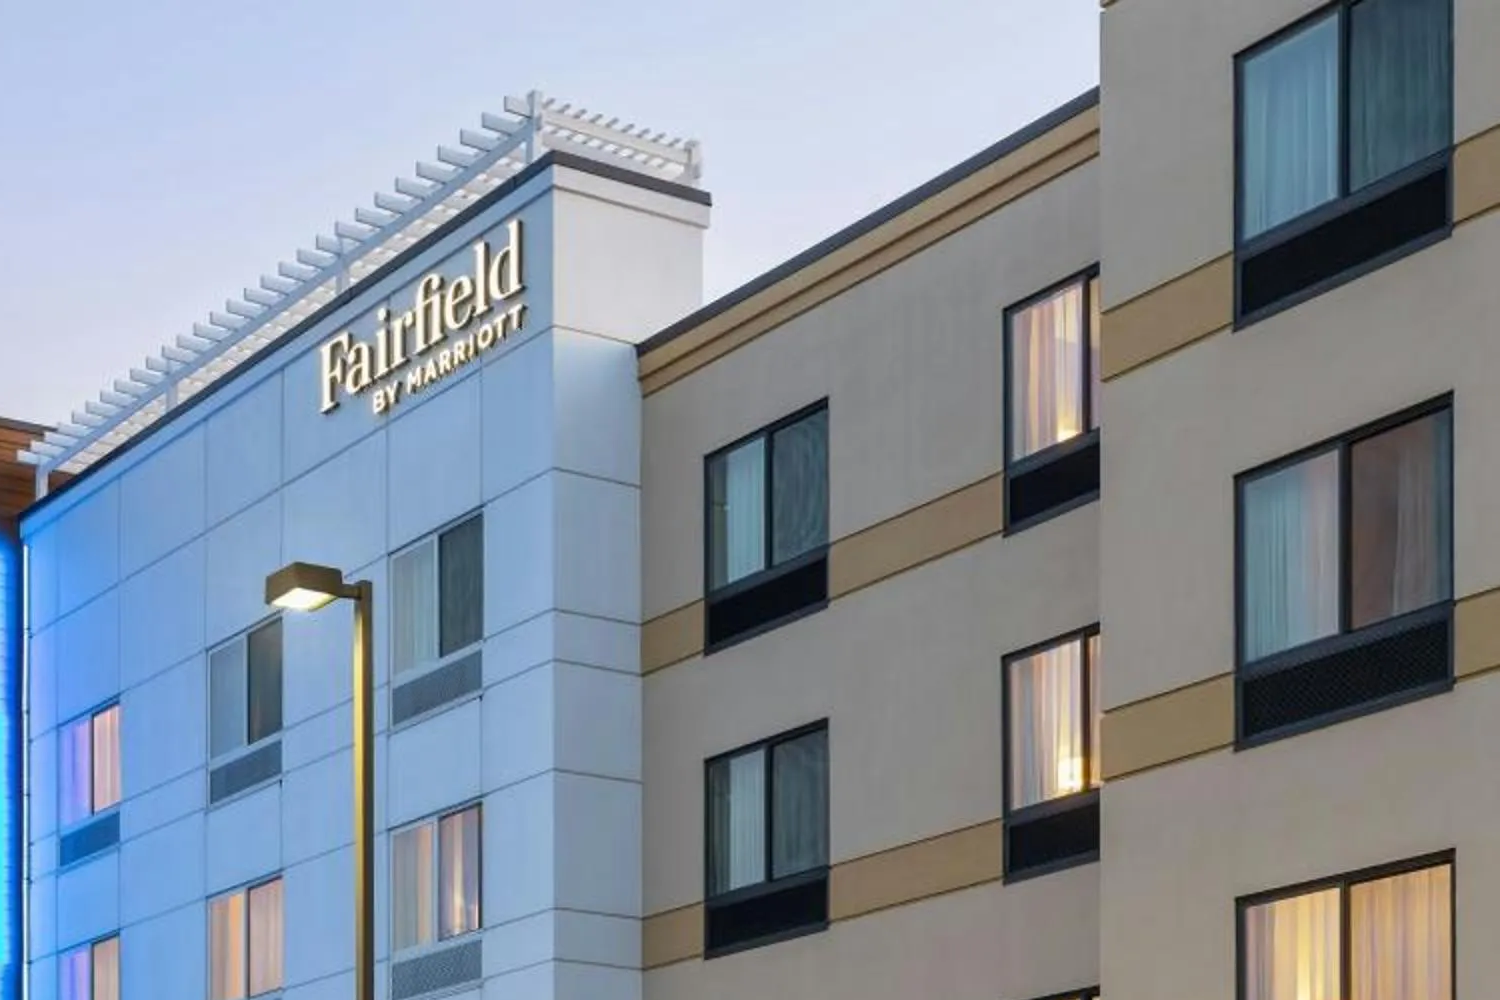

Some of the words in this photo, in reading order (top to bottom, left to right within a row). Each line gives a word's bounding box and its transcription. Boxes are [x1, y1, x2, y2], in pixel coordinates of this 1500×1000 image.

[320, 218, 524, 413] Fairfield
[373, 382, 400, 414] BY
[407, 304, 525, 393] MARRIOTT
